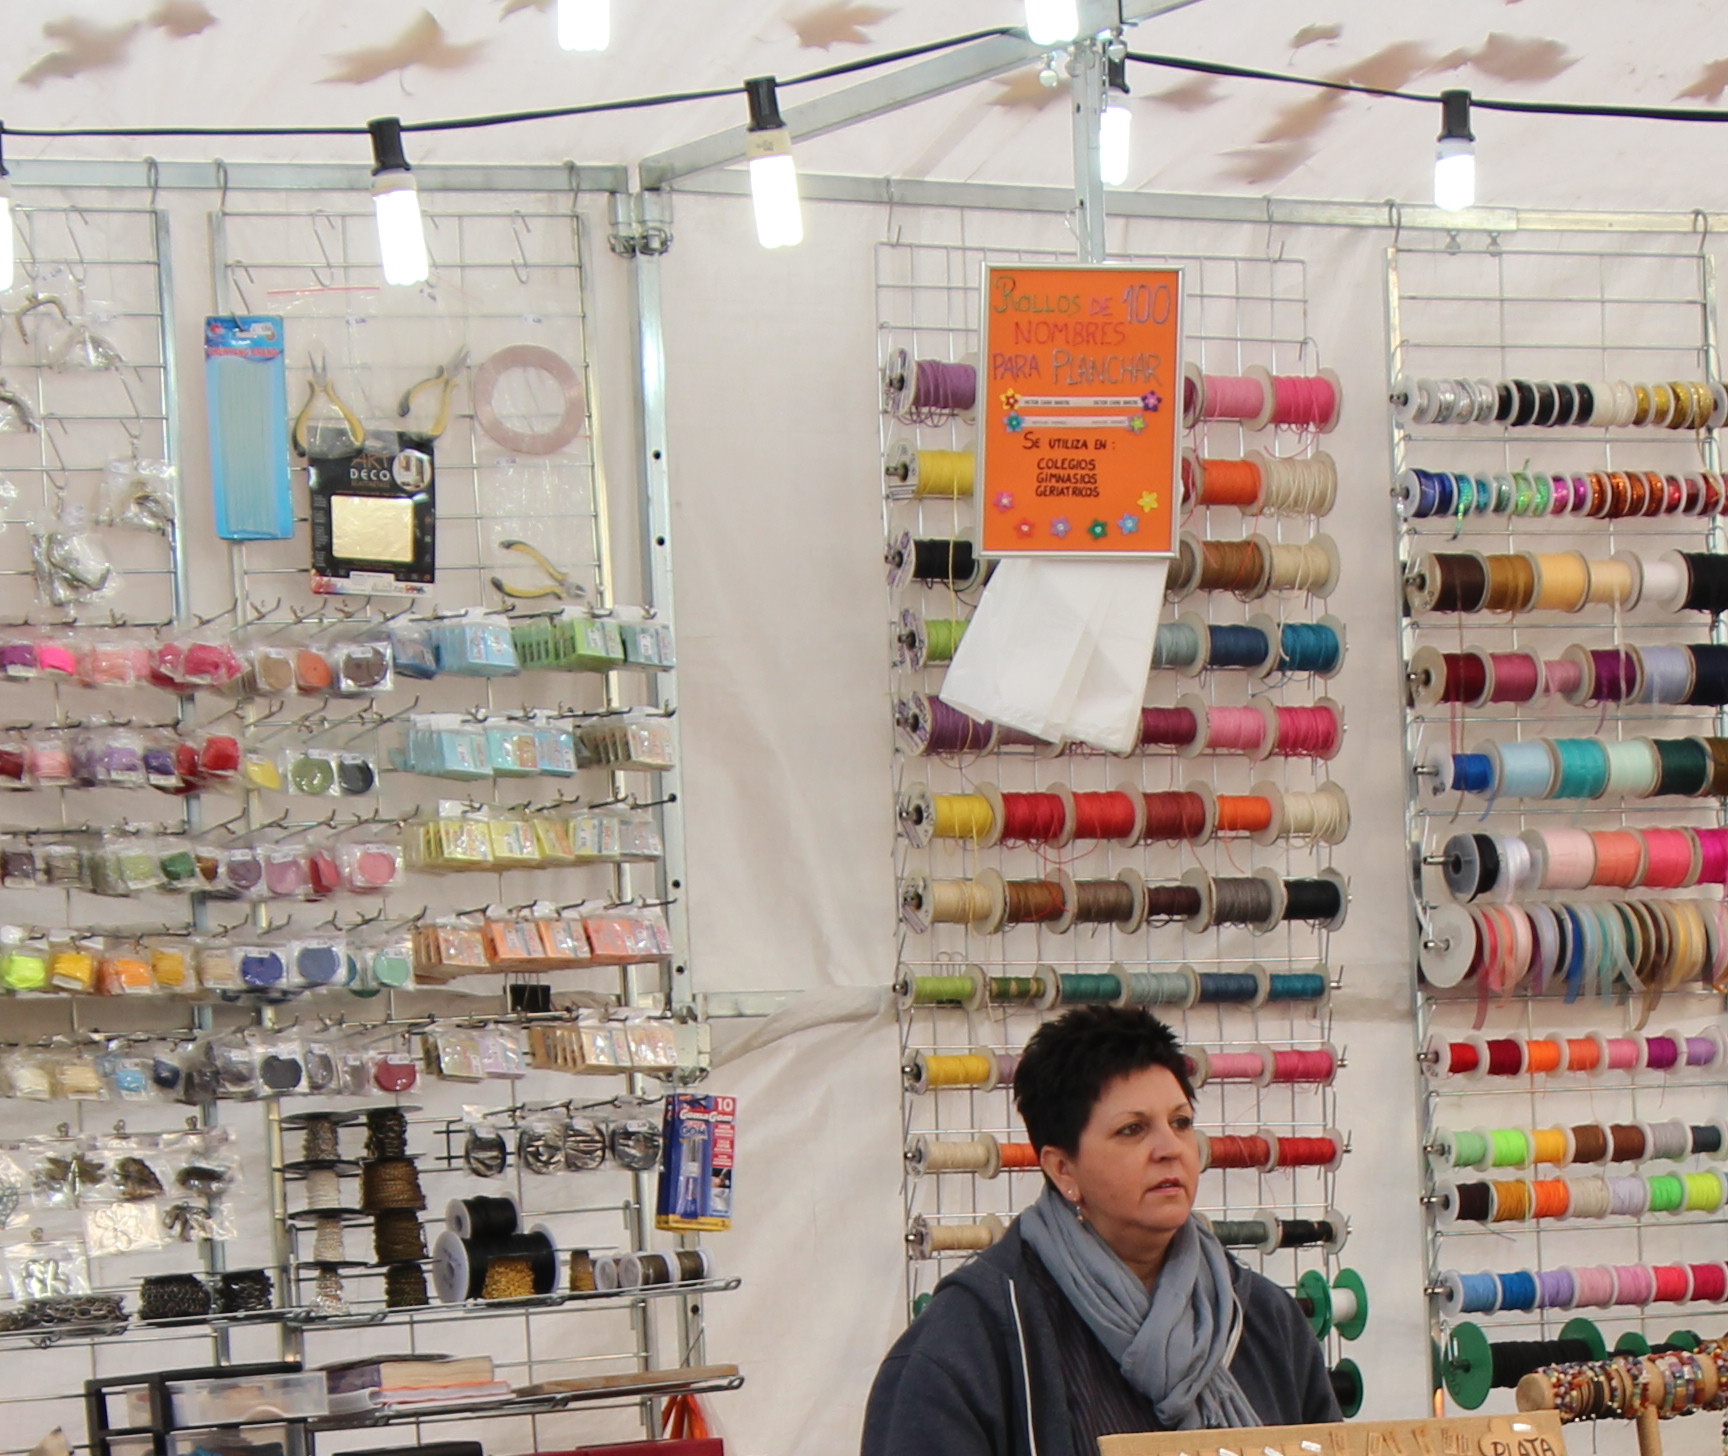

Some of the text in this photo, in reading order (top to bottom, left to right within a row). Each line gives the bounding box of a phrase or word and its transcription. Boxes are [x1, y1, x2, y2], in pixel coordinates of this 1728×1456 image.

[1090, 297, 1113, 316] DE
[1122, 284, 1171, 325] 100
[1014, 320, 1126, 346] NOMBRES
[992, 348, 1163, 387] PARA PLANCHAR
[1022, 431, 1040, 450] SE
[1048, 438, 1088, 450] UTILIZA
[1037, 458, 1096, 471] COLEGIOS
[1036, 472, 1097, 485] GIMNASIOS
[1035, 485, 1100, 498] GERIATRICOS
[716, 1097, 734, 1112] 10
